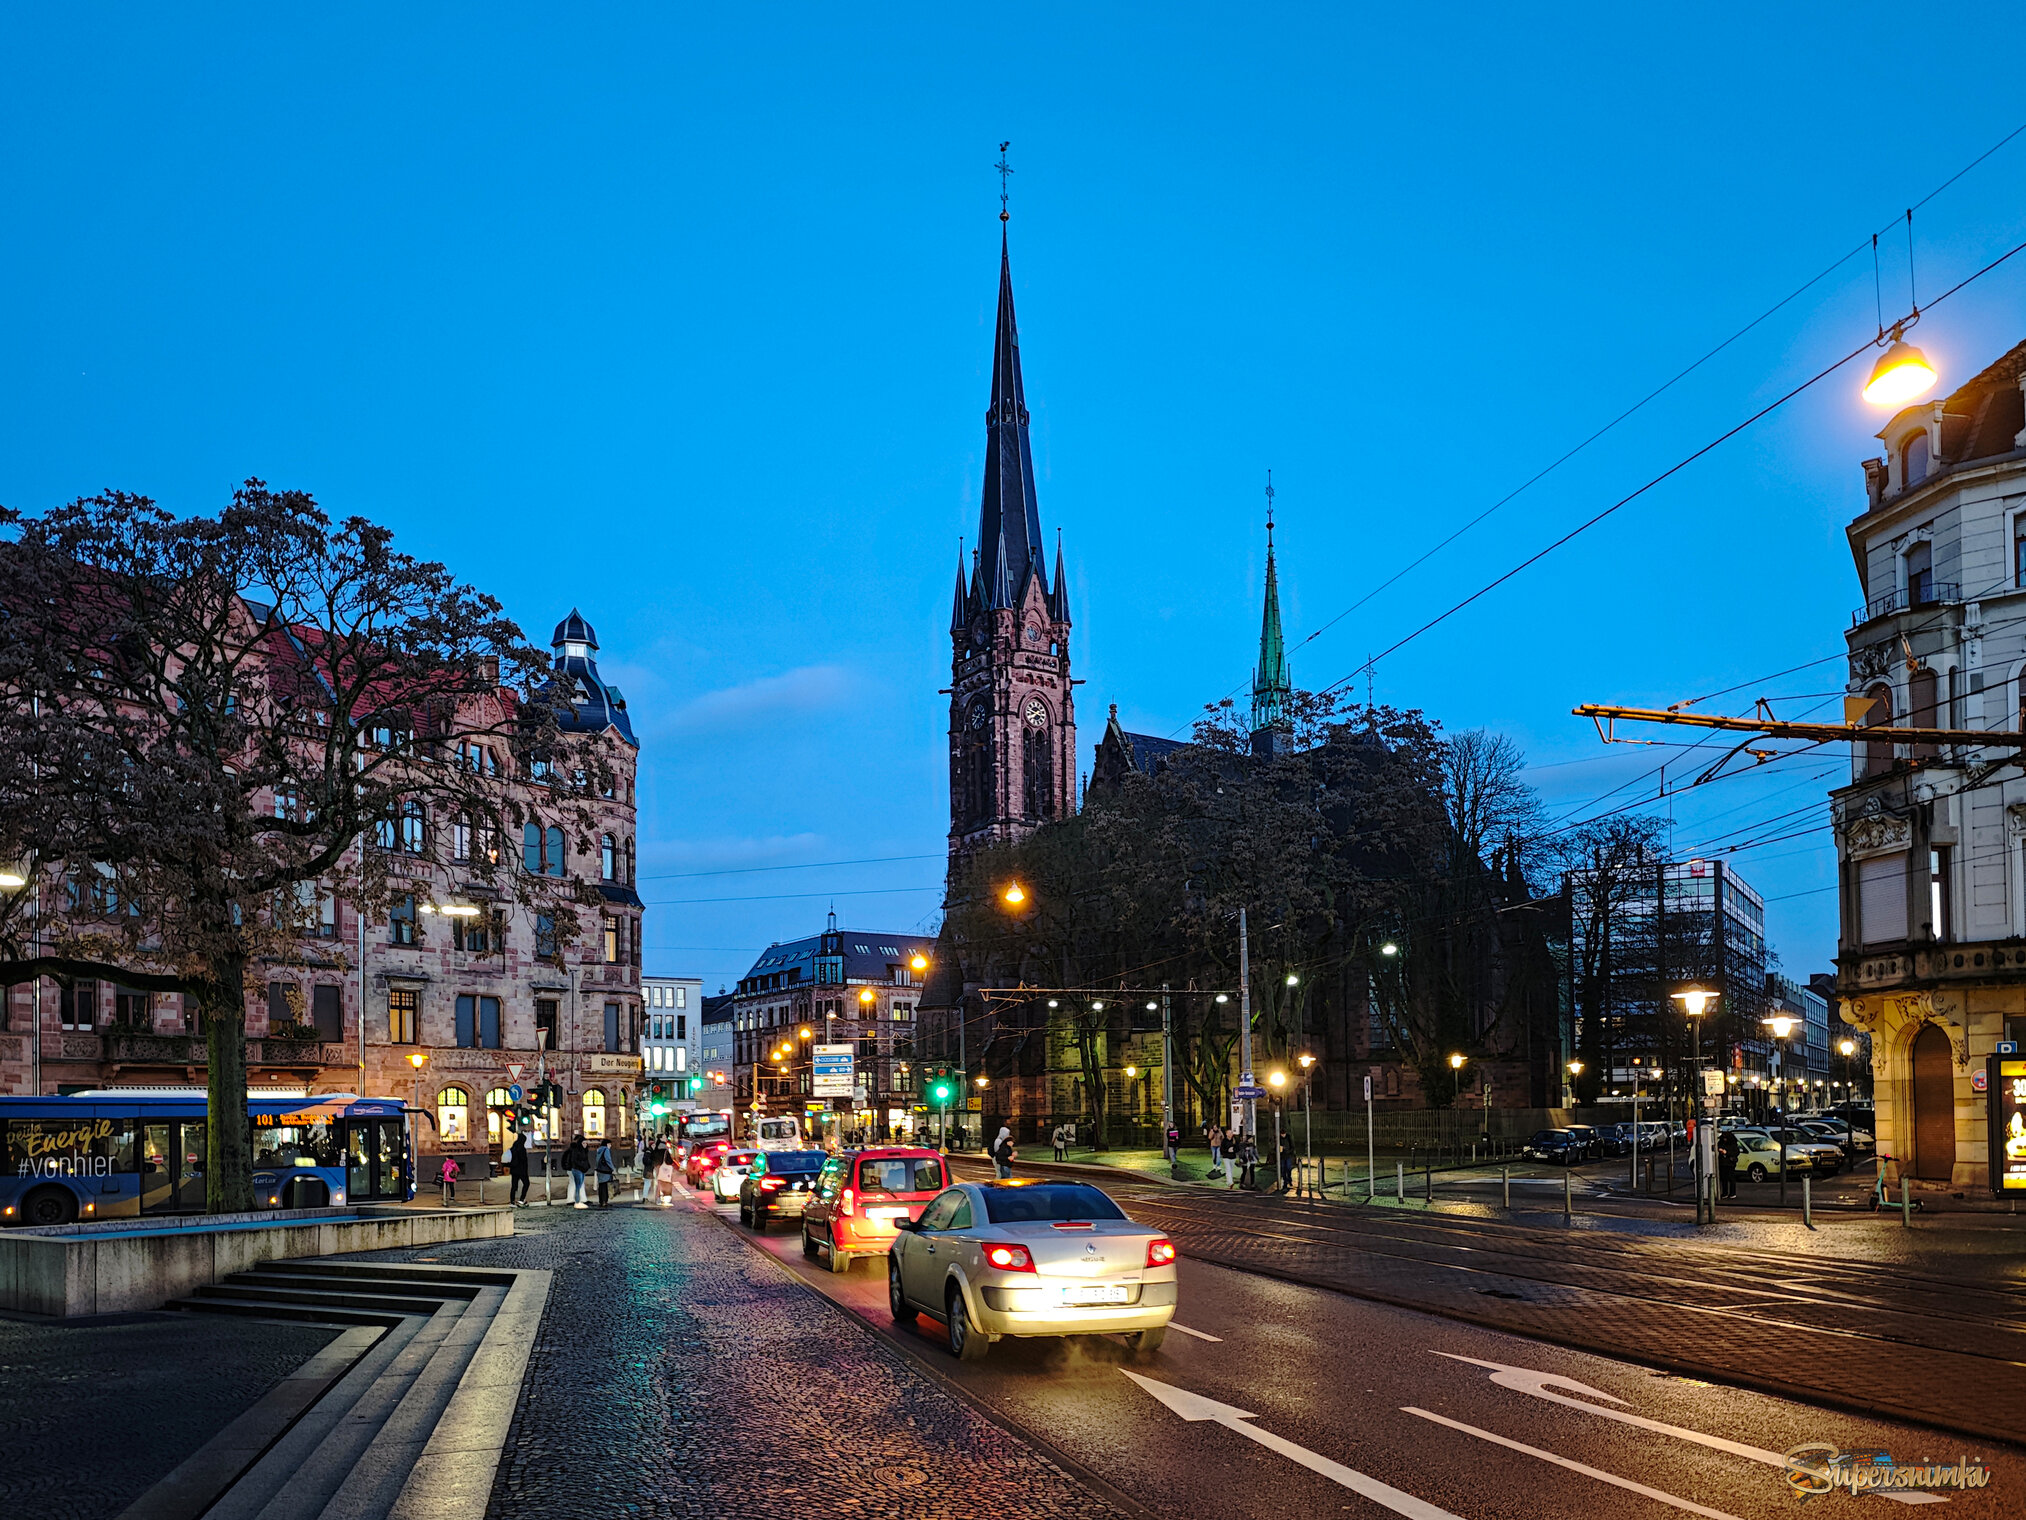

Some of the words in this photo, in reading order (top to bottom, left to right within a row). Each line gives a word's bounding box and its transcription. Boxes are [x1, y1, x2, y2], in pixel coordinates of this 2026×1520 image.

[601, 1057, 614, 1066] Der
[257, 1114, 273, 1126] 101
[26, 1119, 115, 1157] Energie
[17, 1148, 116, 1179] #vonhier
